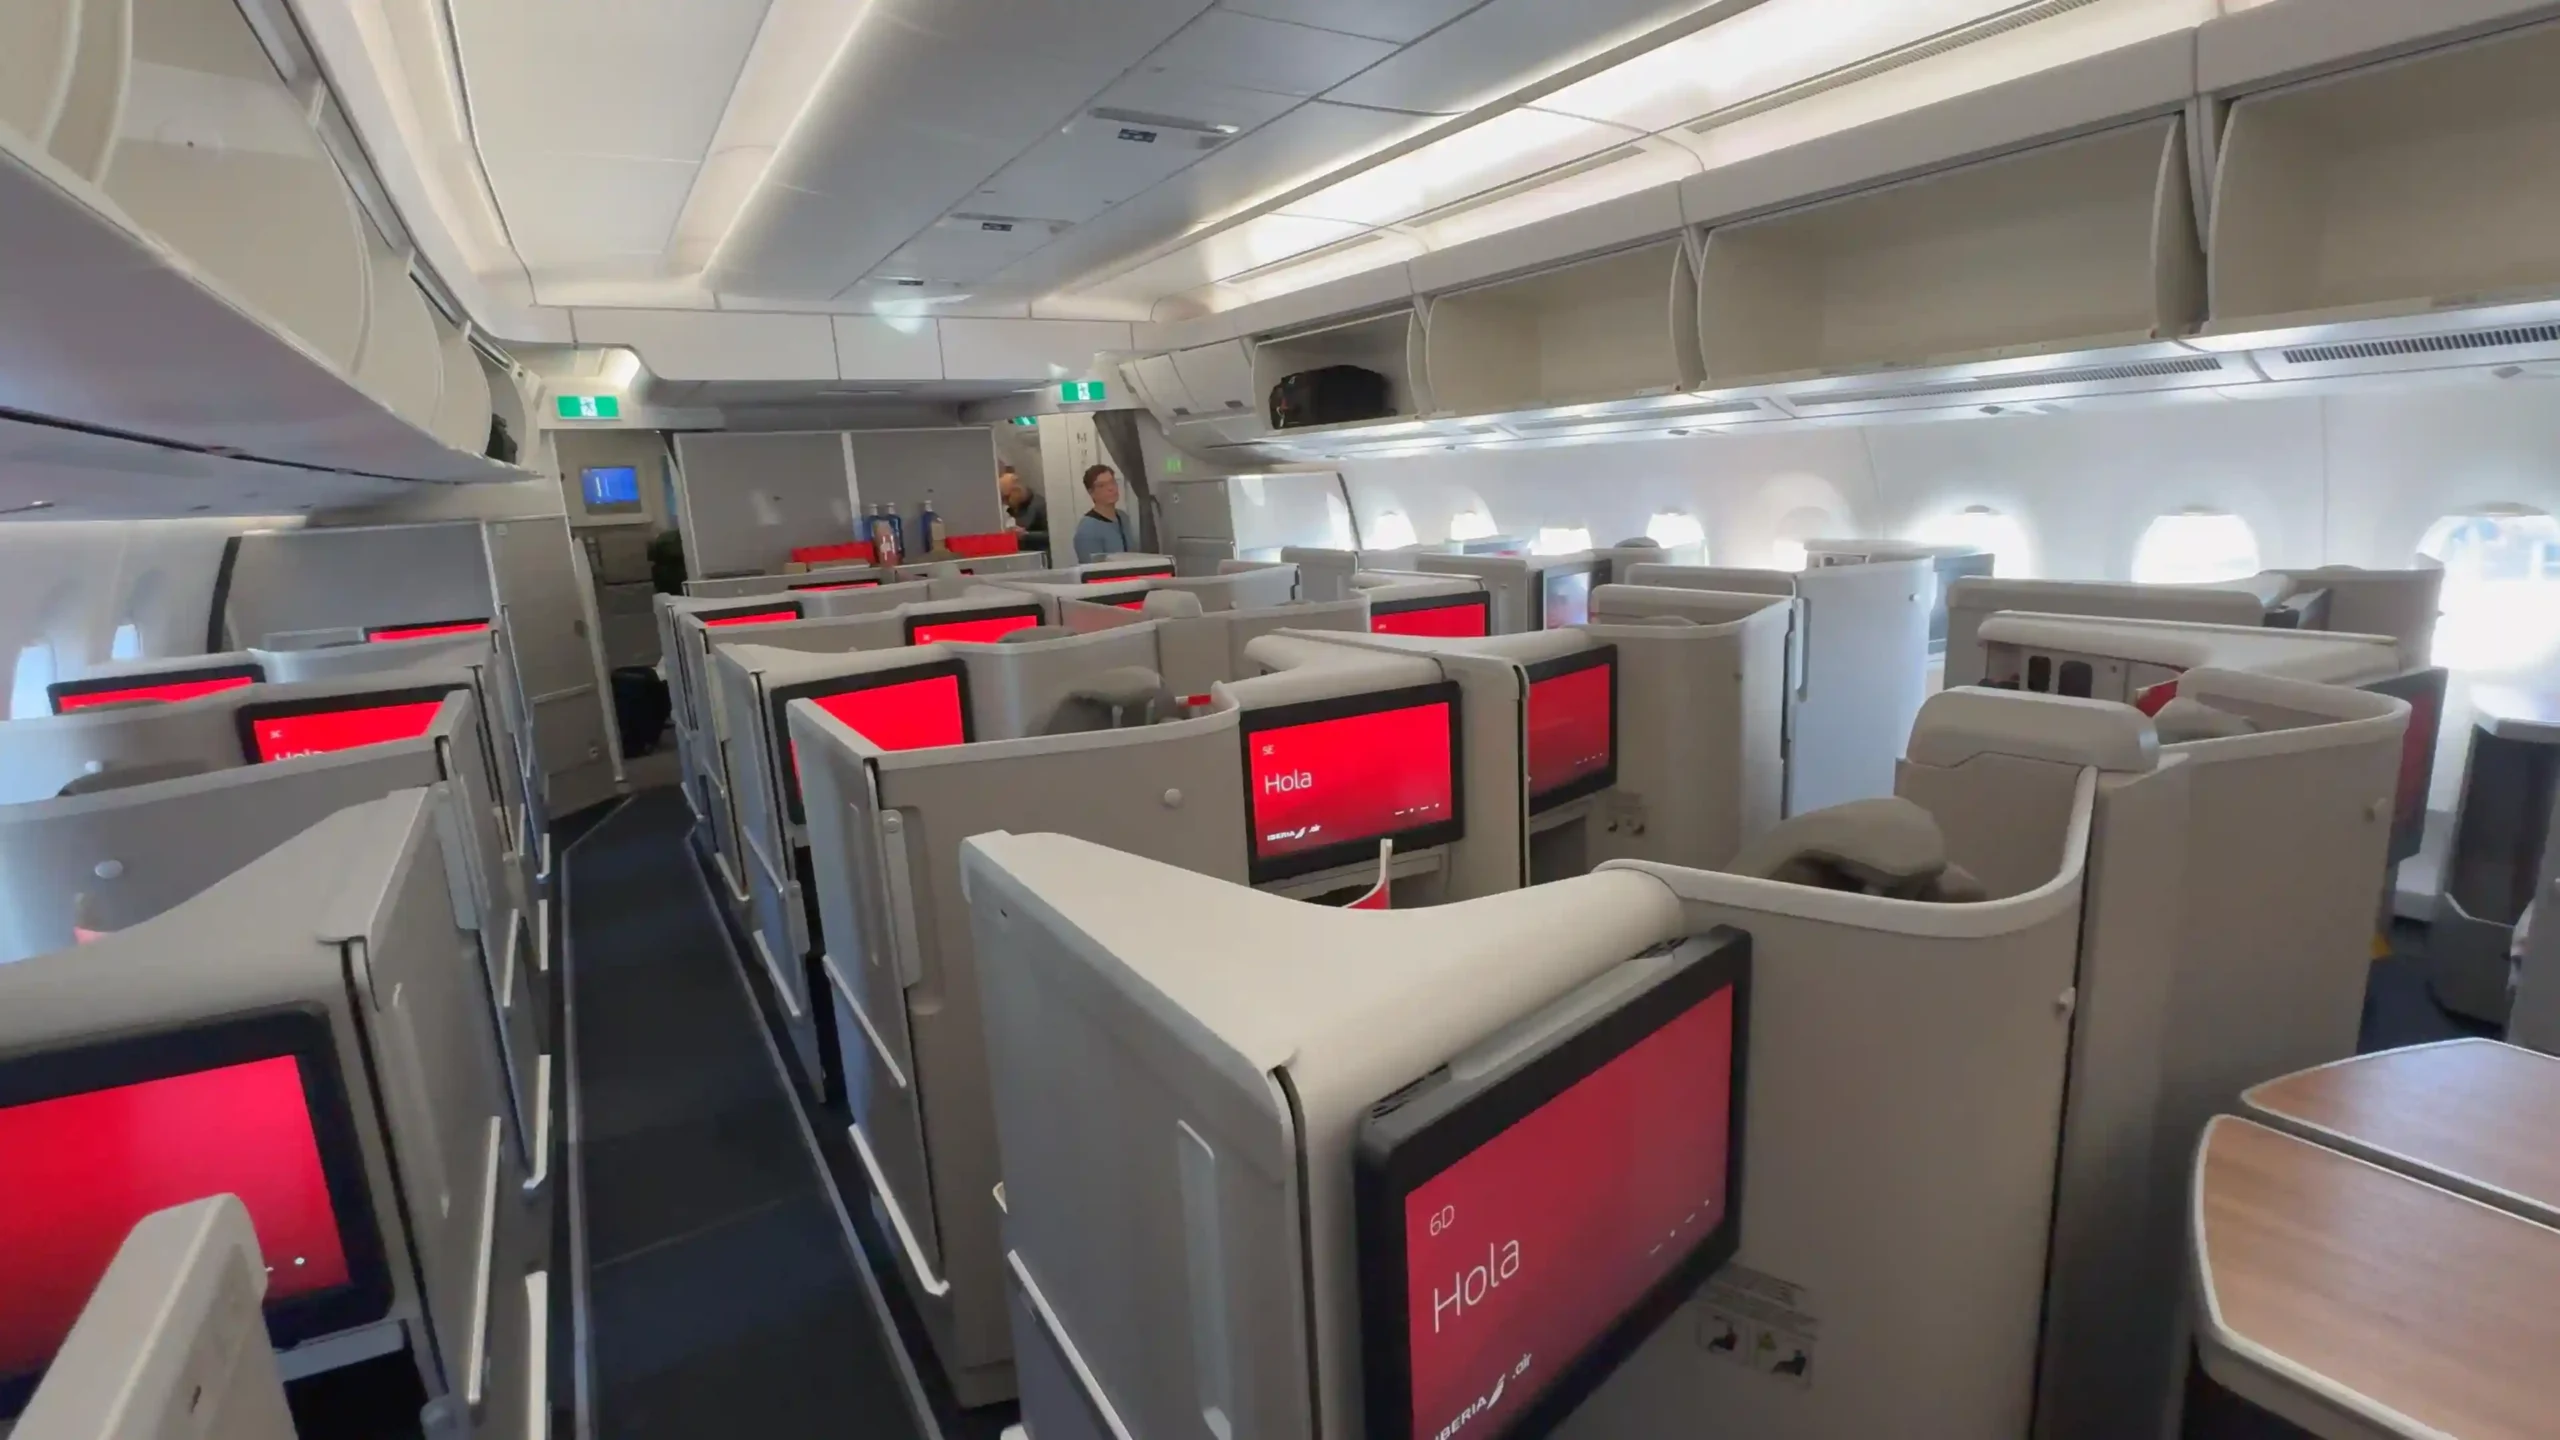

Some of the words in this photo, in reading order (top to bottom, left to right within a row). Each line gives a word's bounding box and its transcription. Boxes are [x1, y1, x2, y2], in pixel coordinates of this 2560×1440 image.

[1265, 769, 1312, 794] Hola
[1429, 1205, 1456, 1237] 6D
[1433, 1239, 1519, 1334] Hola
[1434, 1396, 1488, 1440] BERIA
